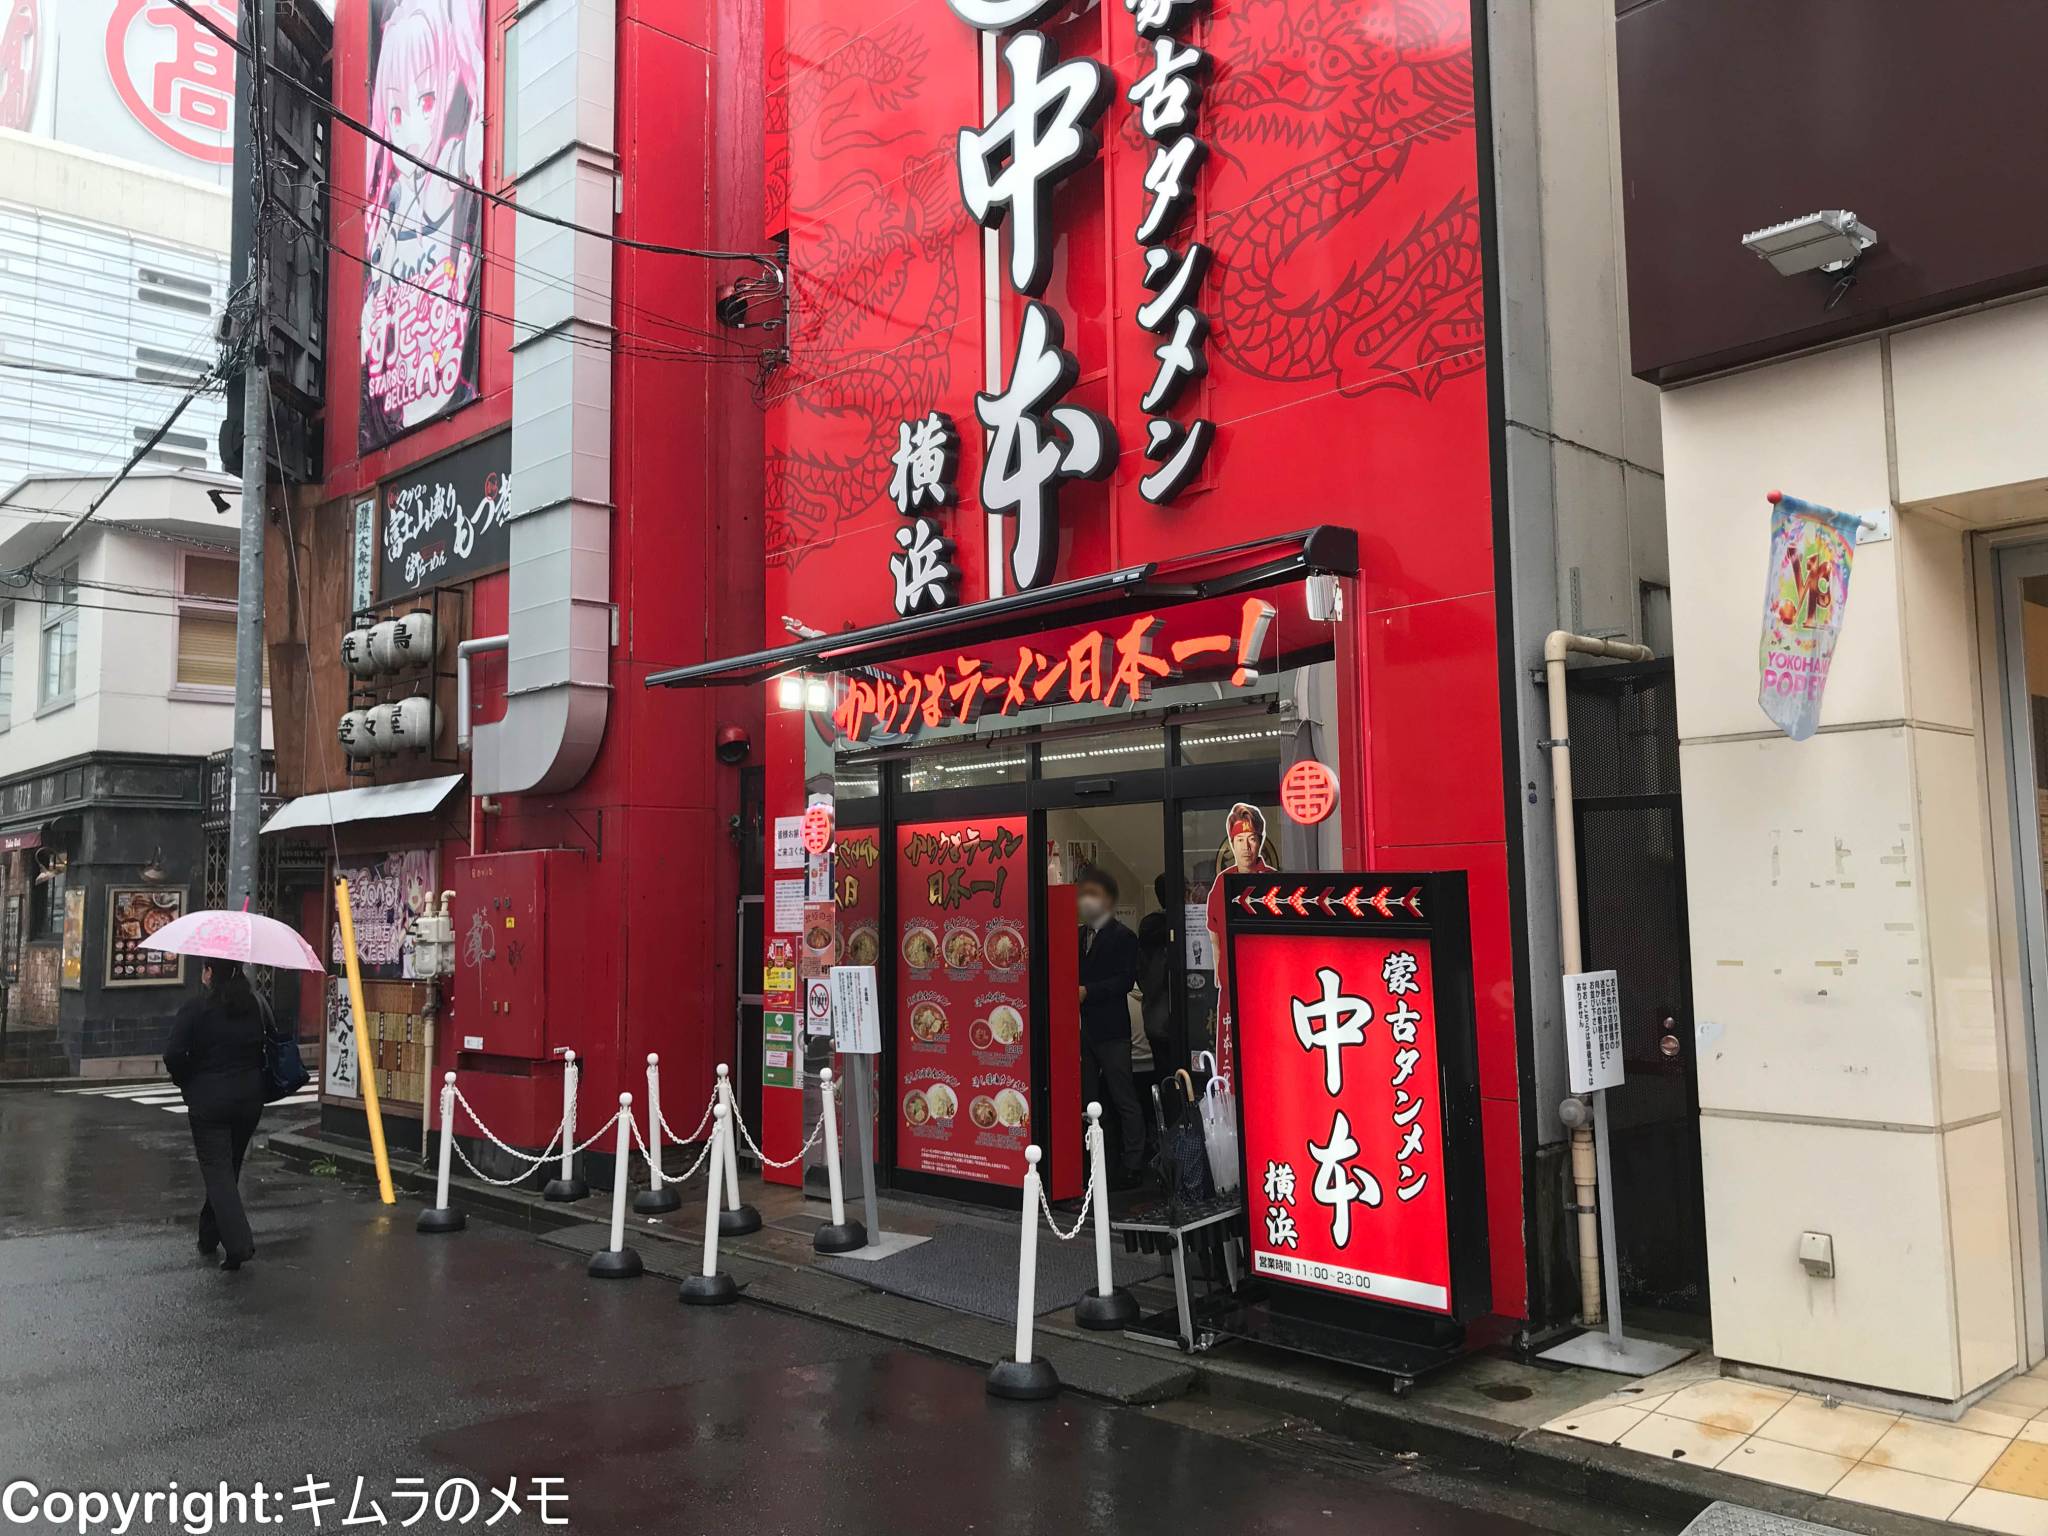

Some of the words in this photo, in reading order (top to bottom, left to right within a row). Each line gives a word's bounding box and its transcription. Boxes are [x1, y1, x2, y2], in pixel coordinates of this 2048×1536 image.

[957, 28, 1118, 591] 中本
[888, 412, 958, 618] 横浜
[1291, 966, 1383, 1250] 中本
[1381, 950, 1429, 1202] 蒙古タンメン
[1259, 1255, 1292, 1273] 営業時間
[1263, 1160, 1299, 1249] 横浜
